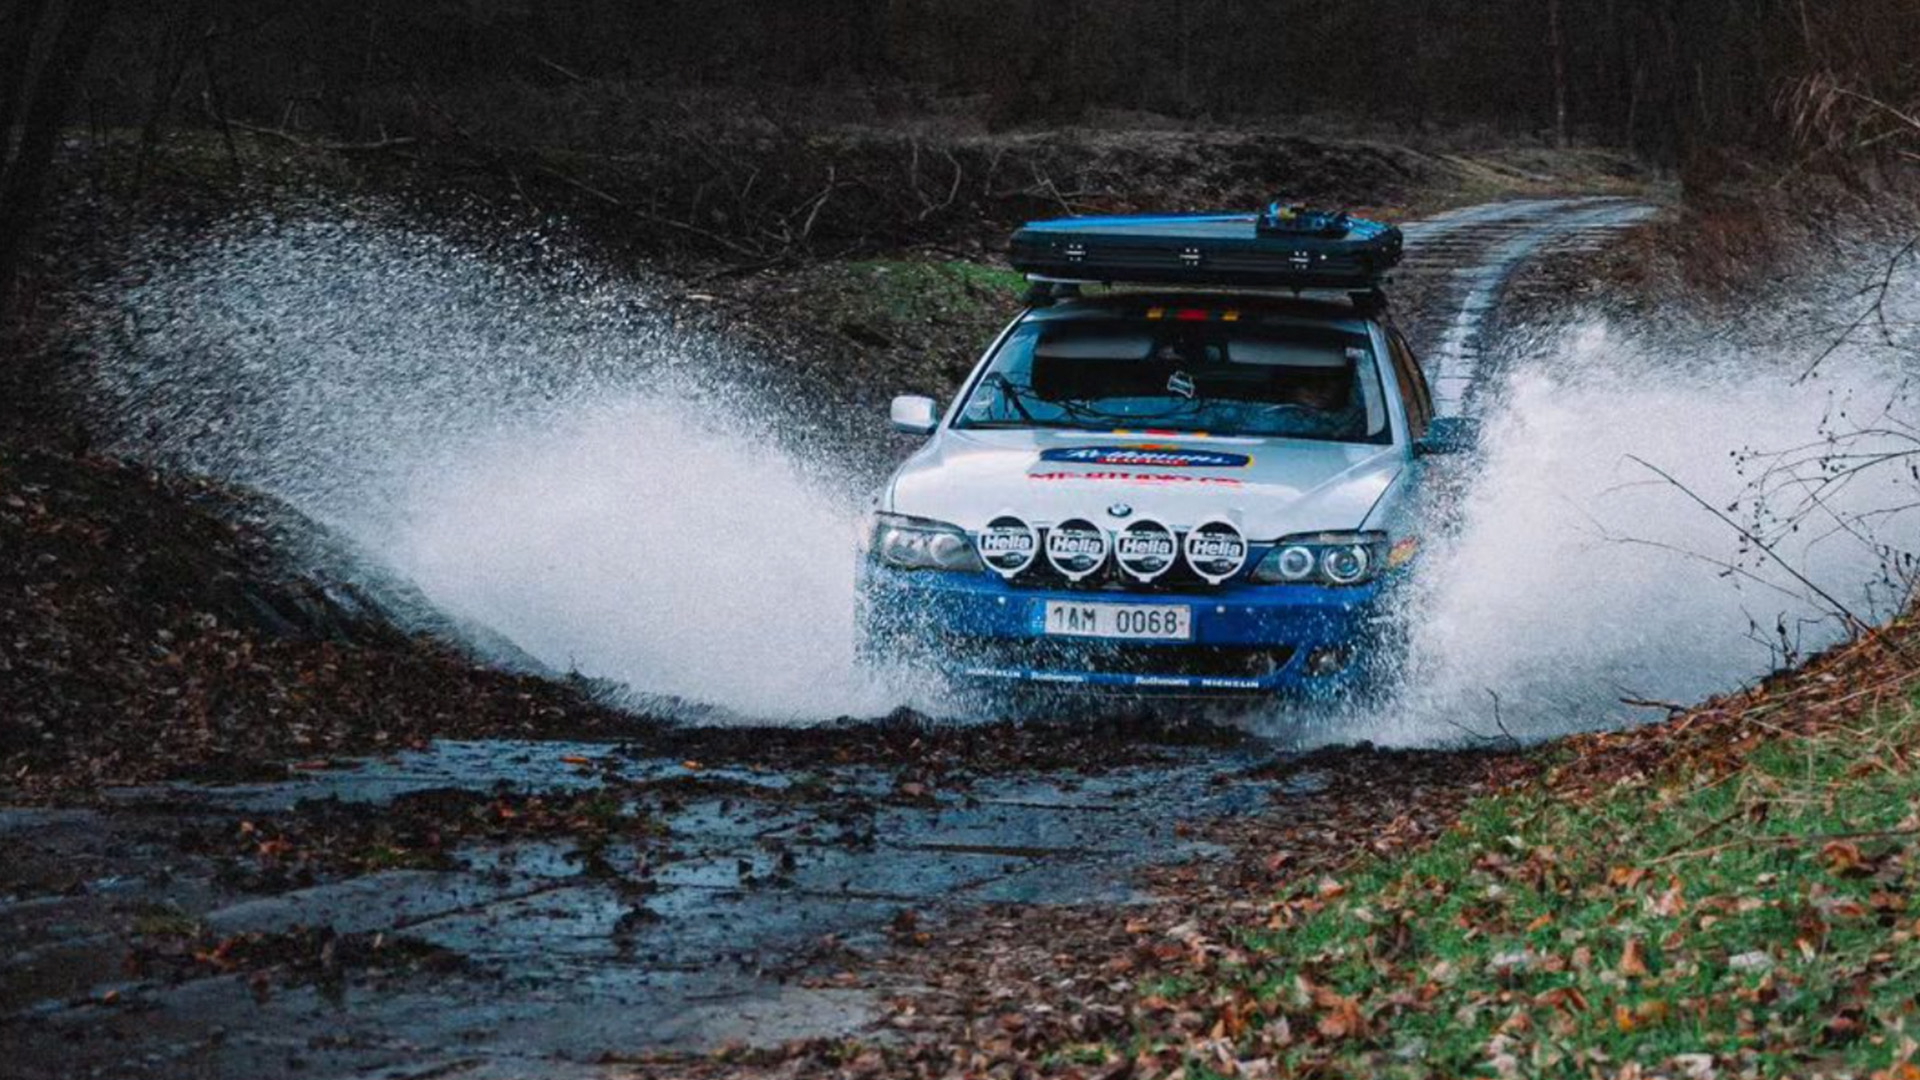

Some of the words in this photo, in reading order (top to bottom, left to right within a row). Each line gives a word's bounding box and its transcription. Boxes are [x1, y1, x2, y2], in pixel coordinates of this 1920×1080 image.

[984, 535, 1031, 550] Hella
[1053, 537, 1101, 552] Hella
[1122, 538, 1170, 554] Hella
[1192, 540, 1241, 556] Hella
[1053, 606, 1096, 631] 1AM
[1116, 609, 1178, 634] 0068
[1201, 678, 1259, 688] MICHELIN
